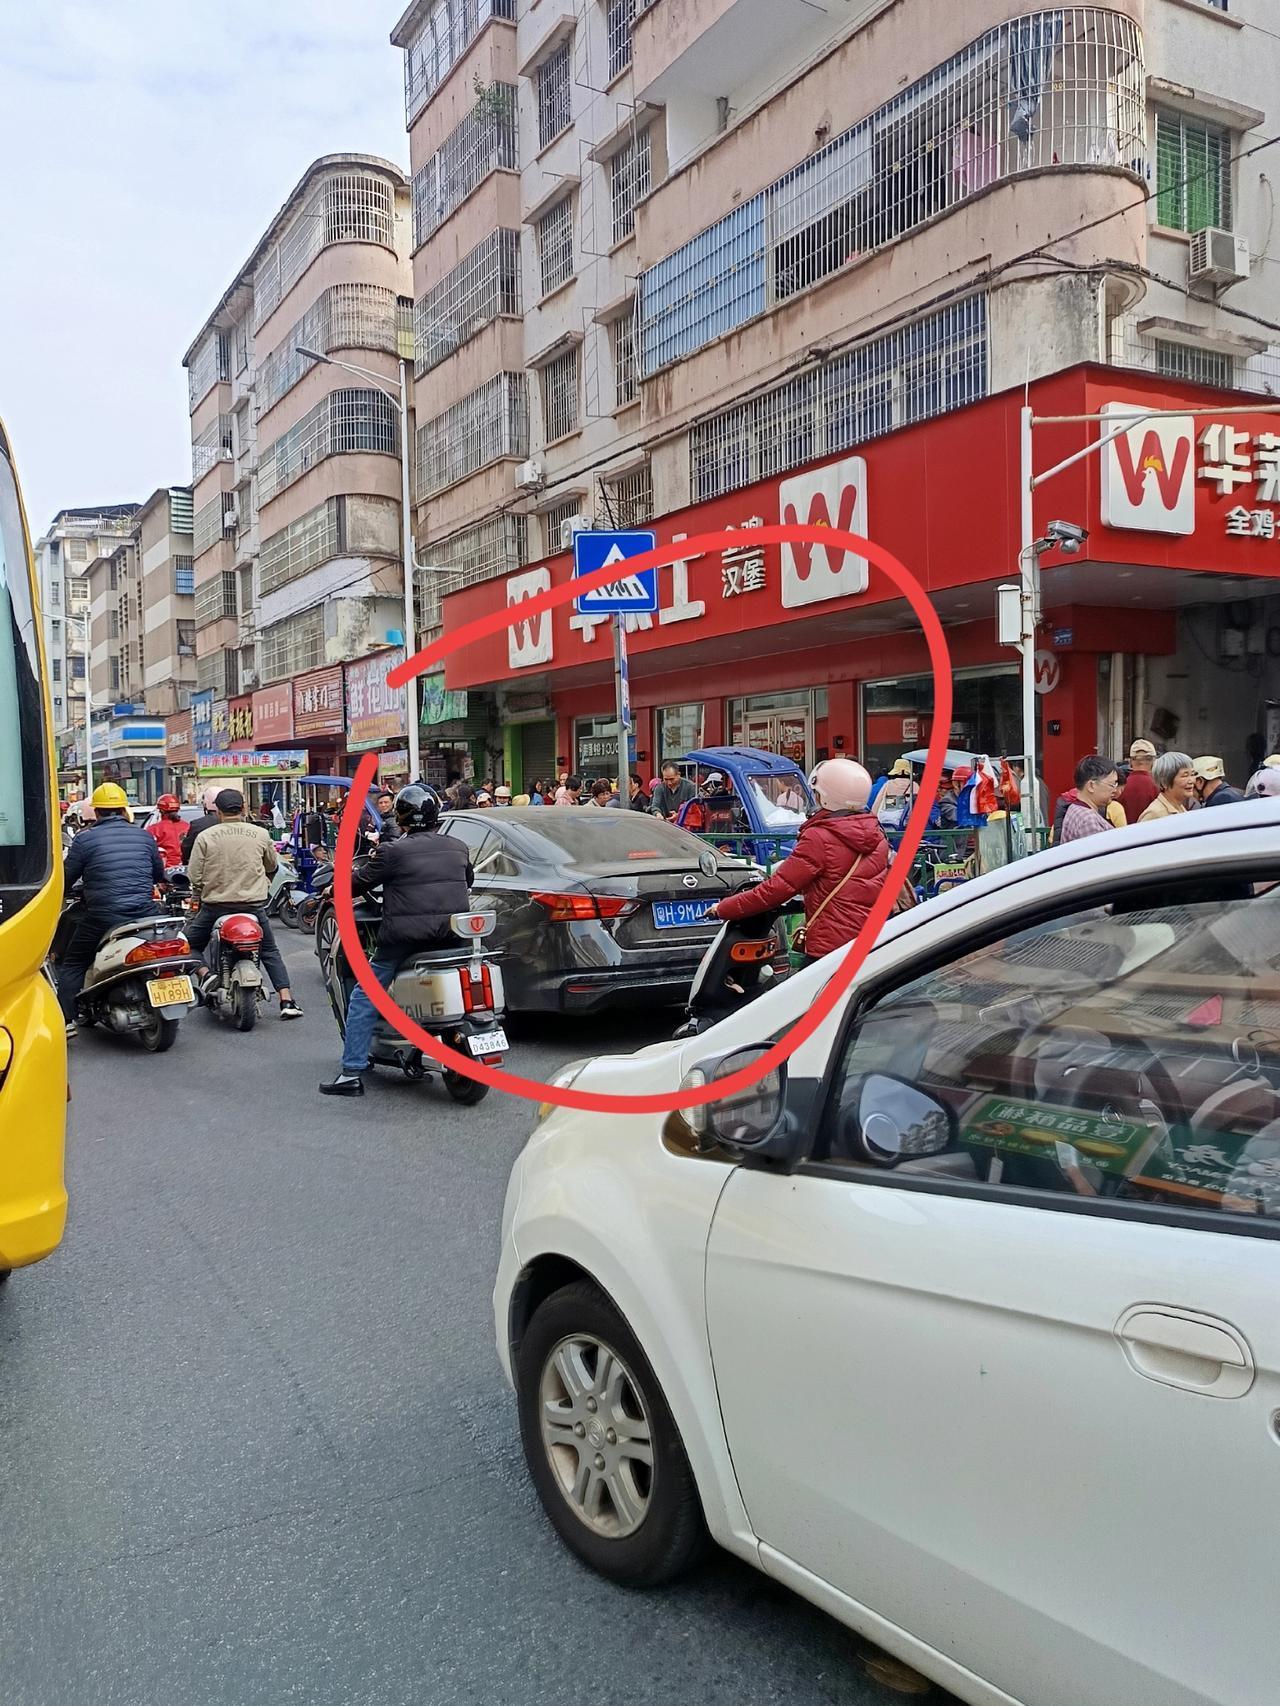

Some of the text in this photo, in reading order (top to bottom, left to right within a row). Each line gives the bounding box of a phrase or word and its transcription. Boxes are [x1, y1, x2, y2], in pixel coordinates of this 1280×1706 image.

[1225, 505, 1280, 538] 全鸡
[722, 558, 766, 598] 汉堡
[656, 901, 711, 923] 粤H·9M4
[400, 1001, 445, 1019] AILG
